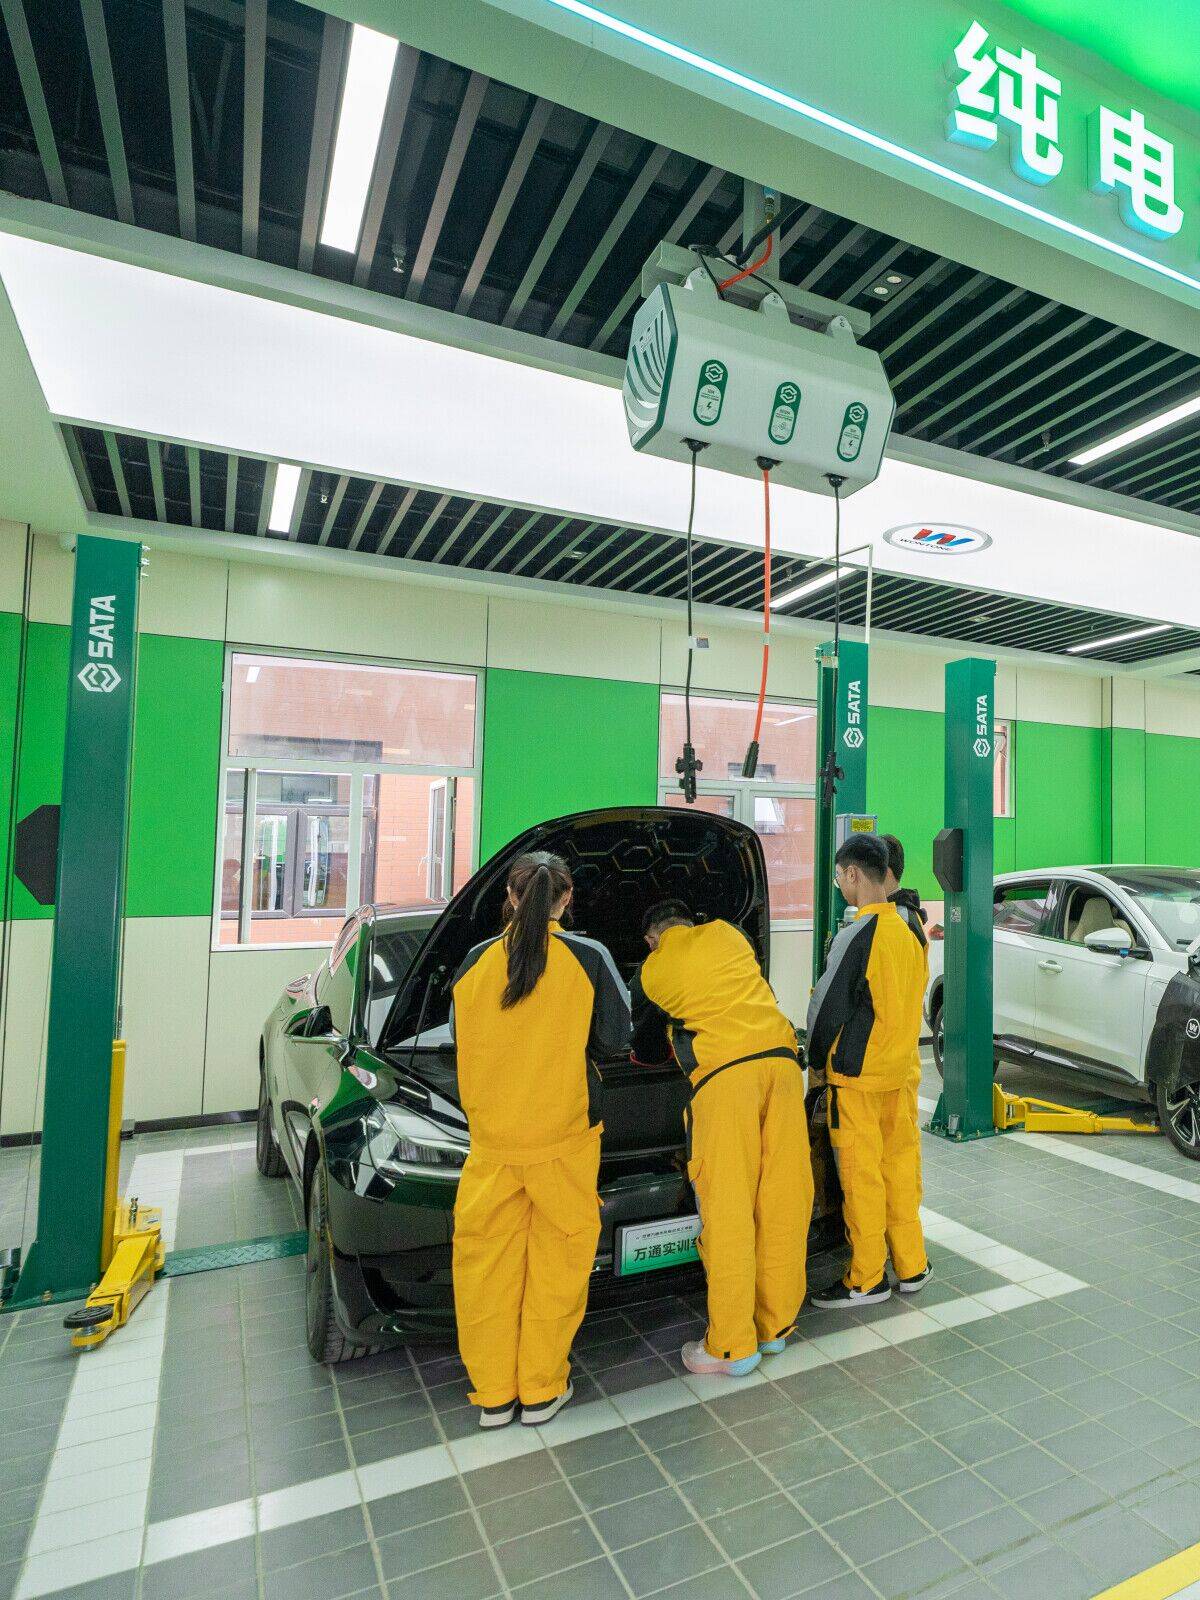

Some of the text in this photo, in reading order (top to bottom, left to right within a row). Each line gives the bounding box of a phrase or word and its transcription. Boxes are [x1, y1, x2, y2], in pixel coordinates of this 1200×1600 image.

[88, 595, 116, 659] SATA
[848, 680, 861, 724] SATA
[976, 694, 988, 736] SATA
